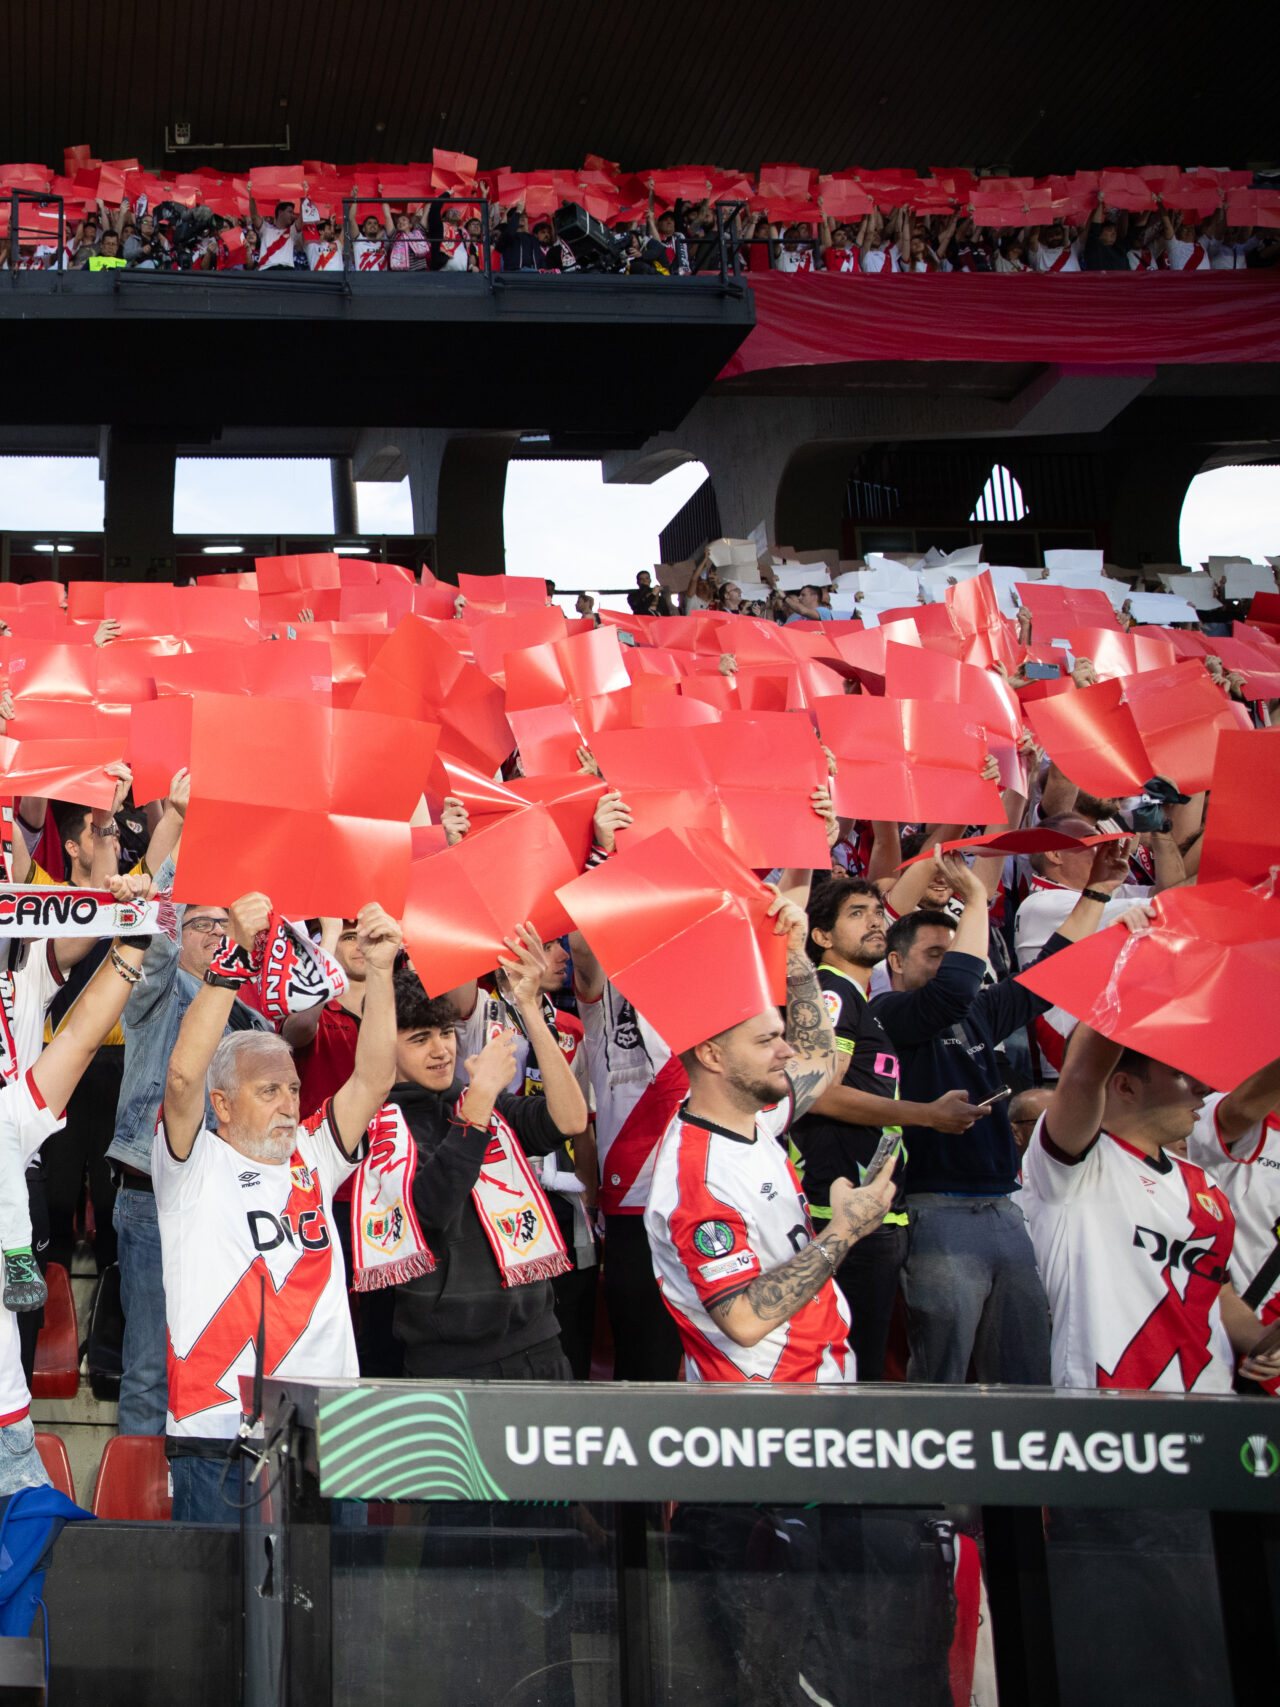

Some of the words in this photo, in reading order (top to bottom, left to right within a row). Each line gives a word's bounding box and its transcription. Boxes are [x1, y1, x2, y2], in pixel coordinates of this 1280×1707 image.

[246, 1207, 330, 1252] DIG
[505, 1425, 639, 1467] UEFA
[647, 1426, 976, 1469] CONFERENCE
